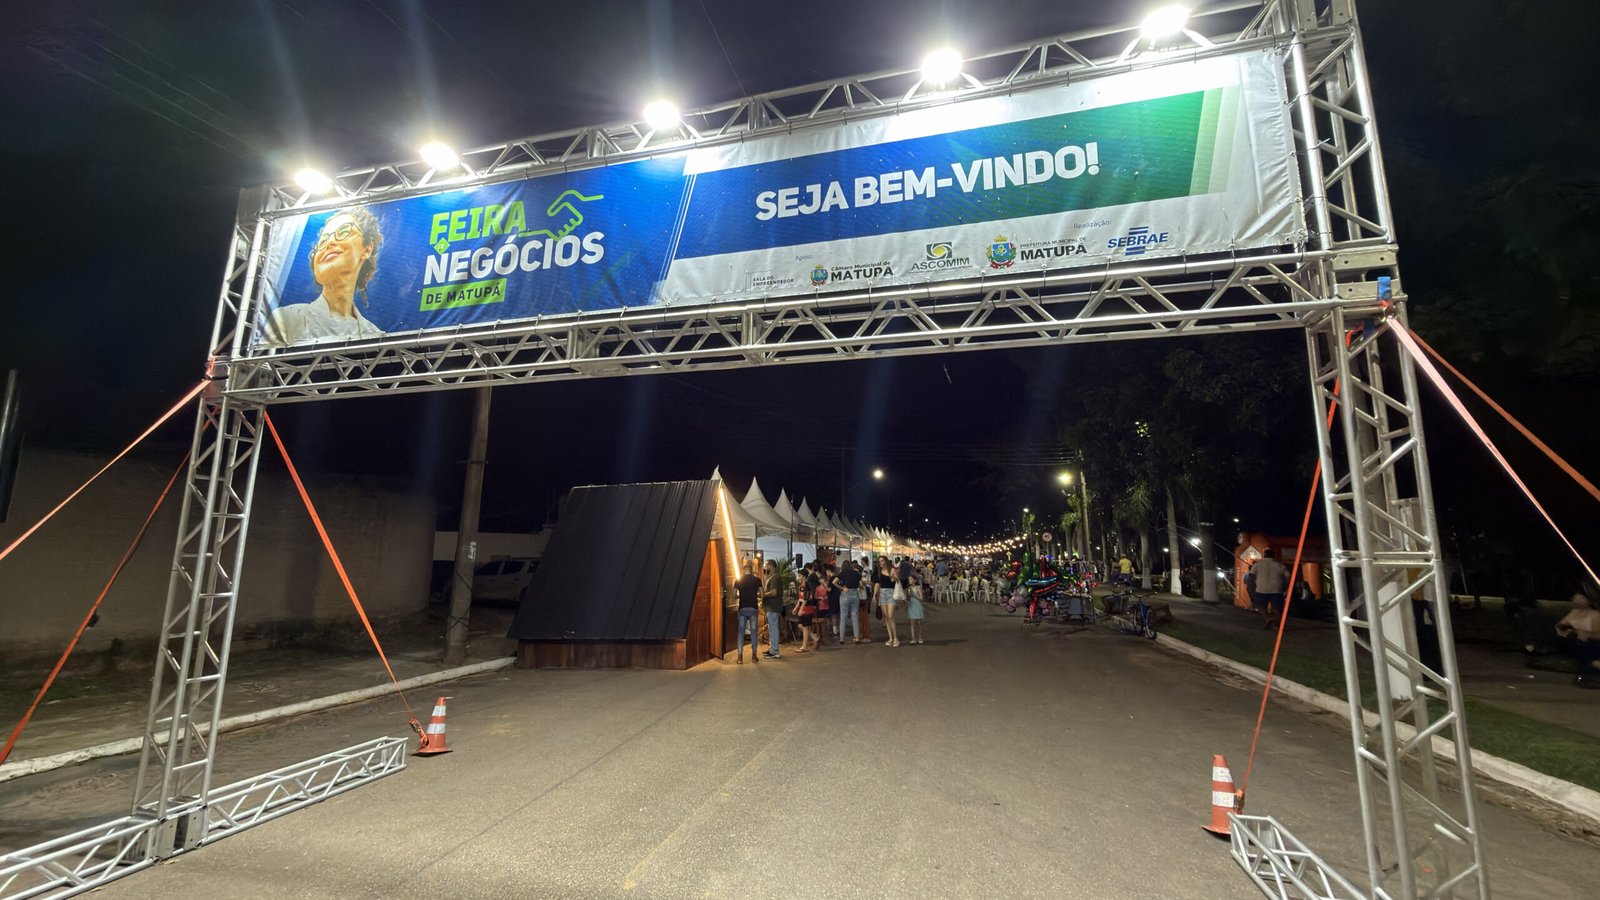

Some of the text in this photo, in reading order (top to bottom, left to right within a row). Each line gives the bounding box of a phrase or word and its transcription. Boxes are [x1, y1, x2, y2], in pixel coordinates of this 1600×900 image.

[755, 142, 1100, 221] SEJA BEM-VINDO!
[429, 200, 527, 245] FEIRA
[1073, 219, 1112, 230] Realização:
[1107, 231, 1169, 249] SEBRAE
[423, 231, 605, 285] NEGÓCIOS
[830, 264, 853, 272] Câmara
[853, 261, 882, 269] Municipal
[911, 257, 970, 271] ASCOMIM
[752, 278, 795, 287] EMPREENDEDOR
[425, 282, 501, 306] DE MATUPÁ
